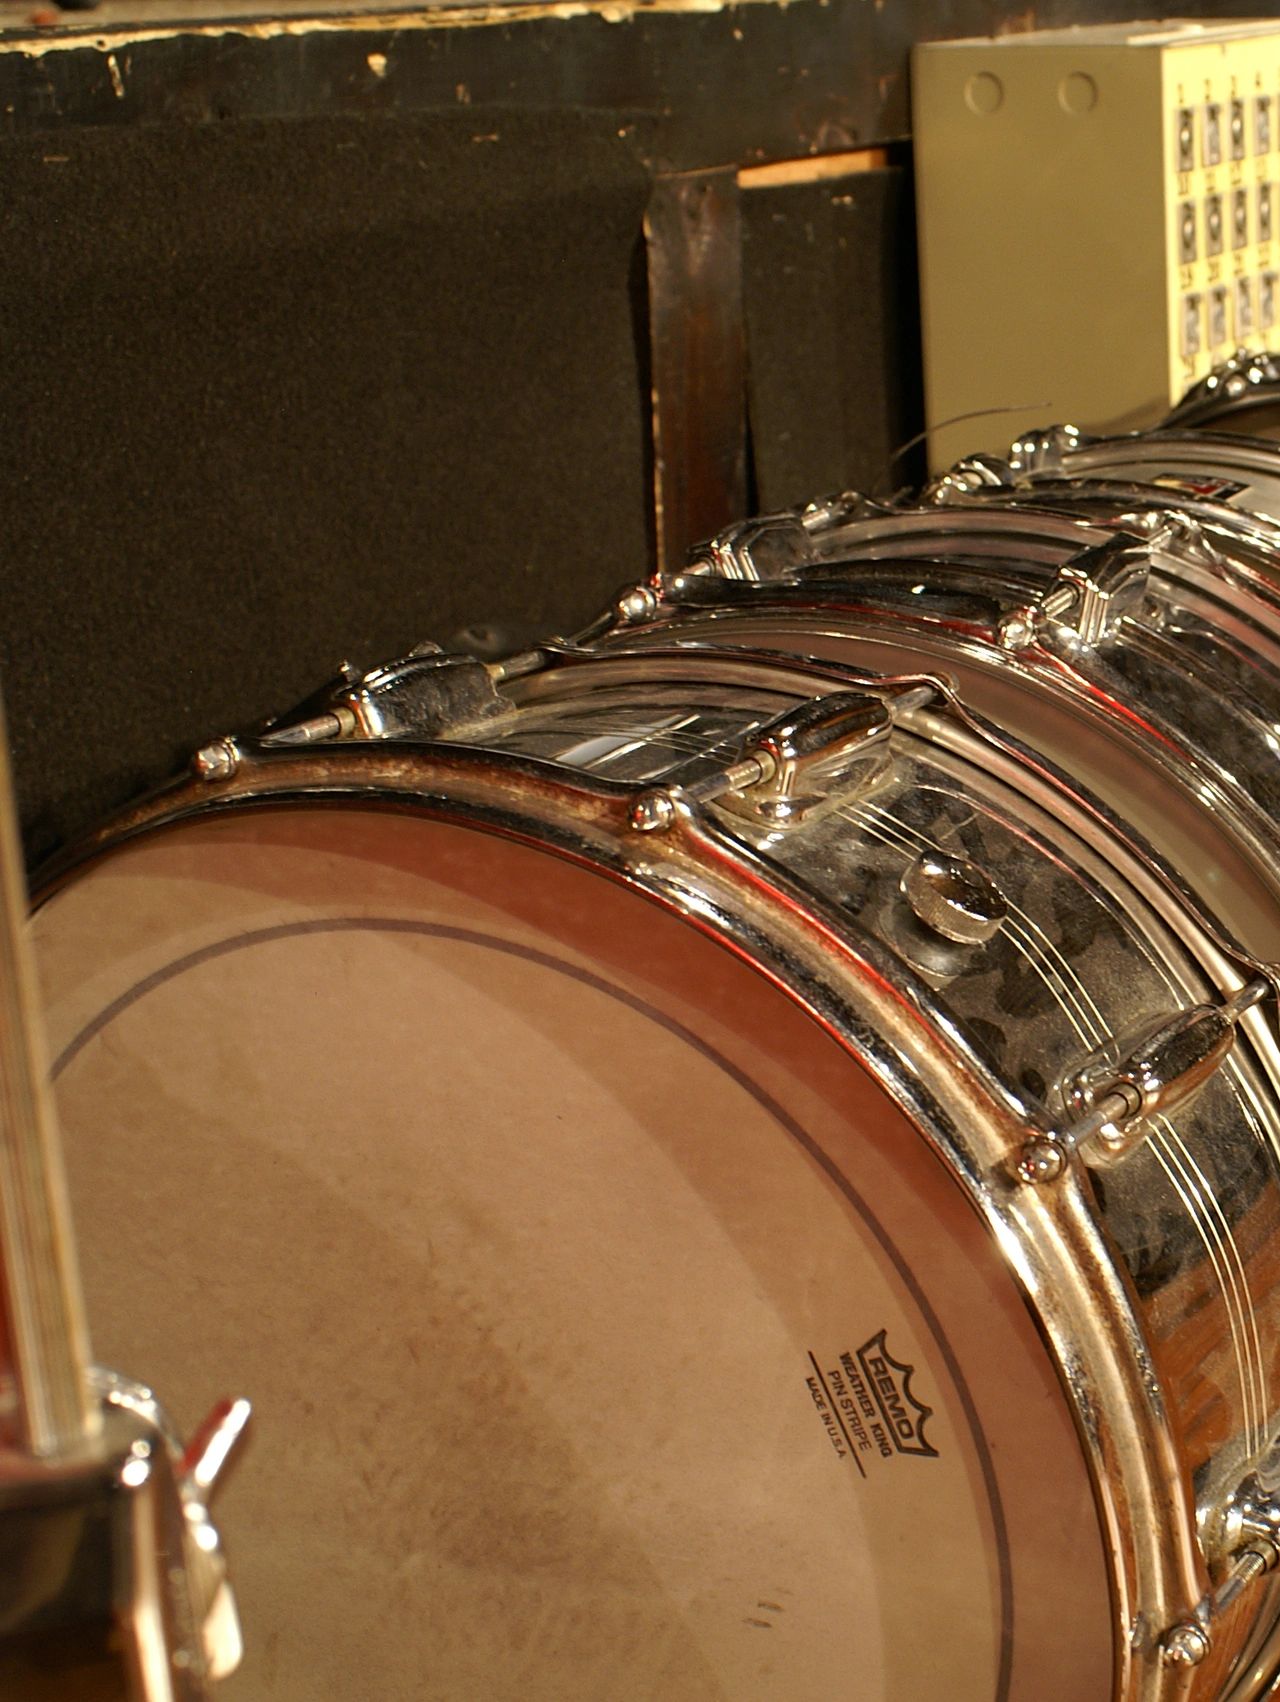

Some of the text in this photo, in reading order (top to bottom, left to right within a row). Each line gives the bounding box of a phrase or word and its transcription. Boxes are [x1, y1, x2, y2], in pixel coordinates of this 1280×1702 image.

[805, 1377, 827, 1411] MADE
[821, 1412, 833, 1426] IN
[827, 1370, 872, 1451] PIN STRIPE
[839, 1352, 892, 1458] WEATHER KING
[868, 1357, 914, 1439] REMO
